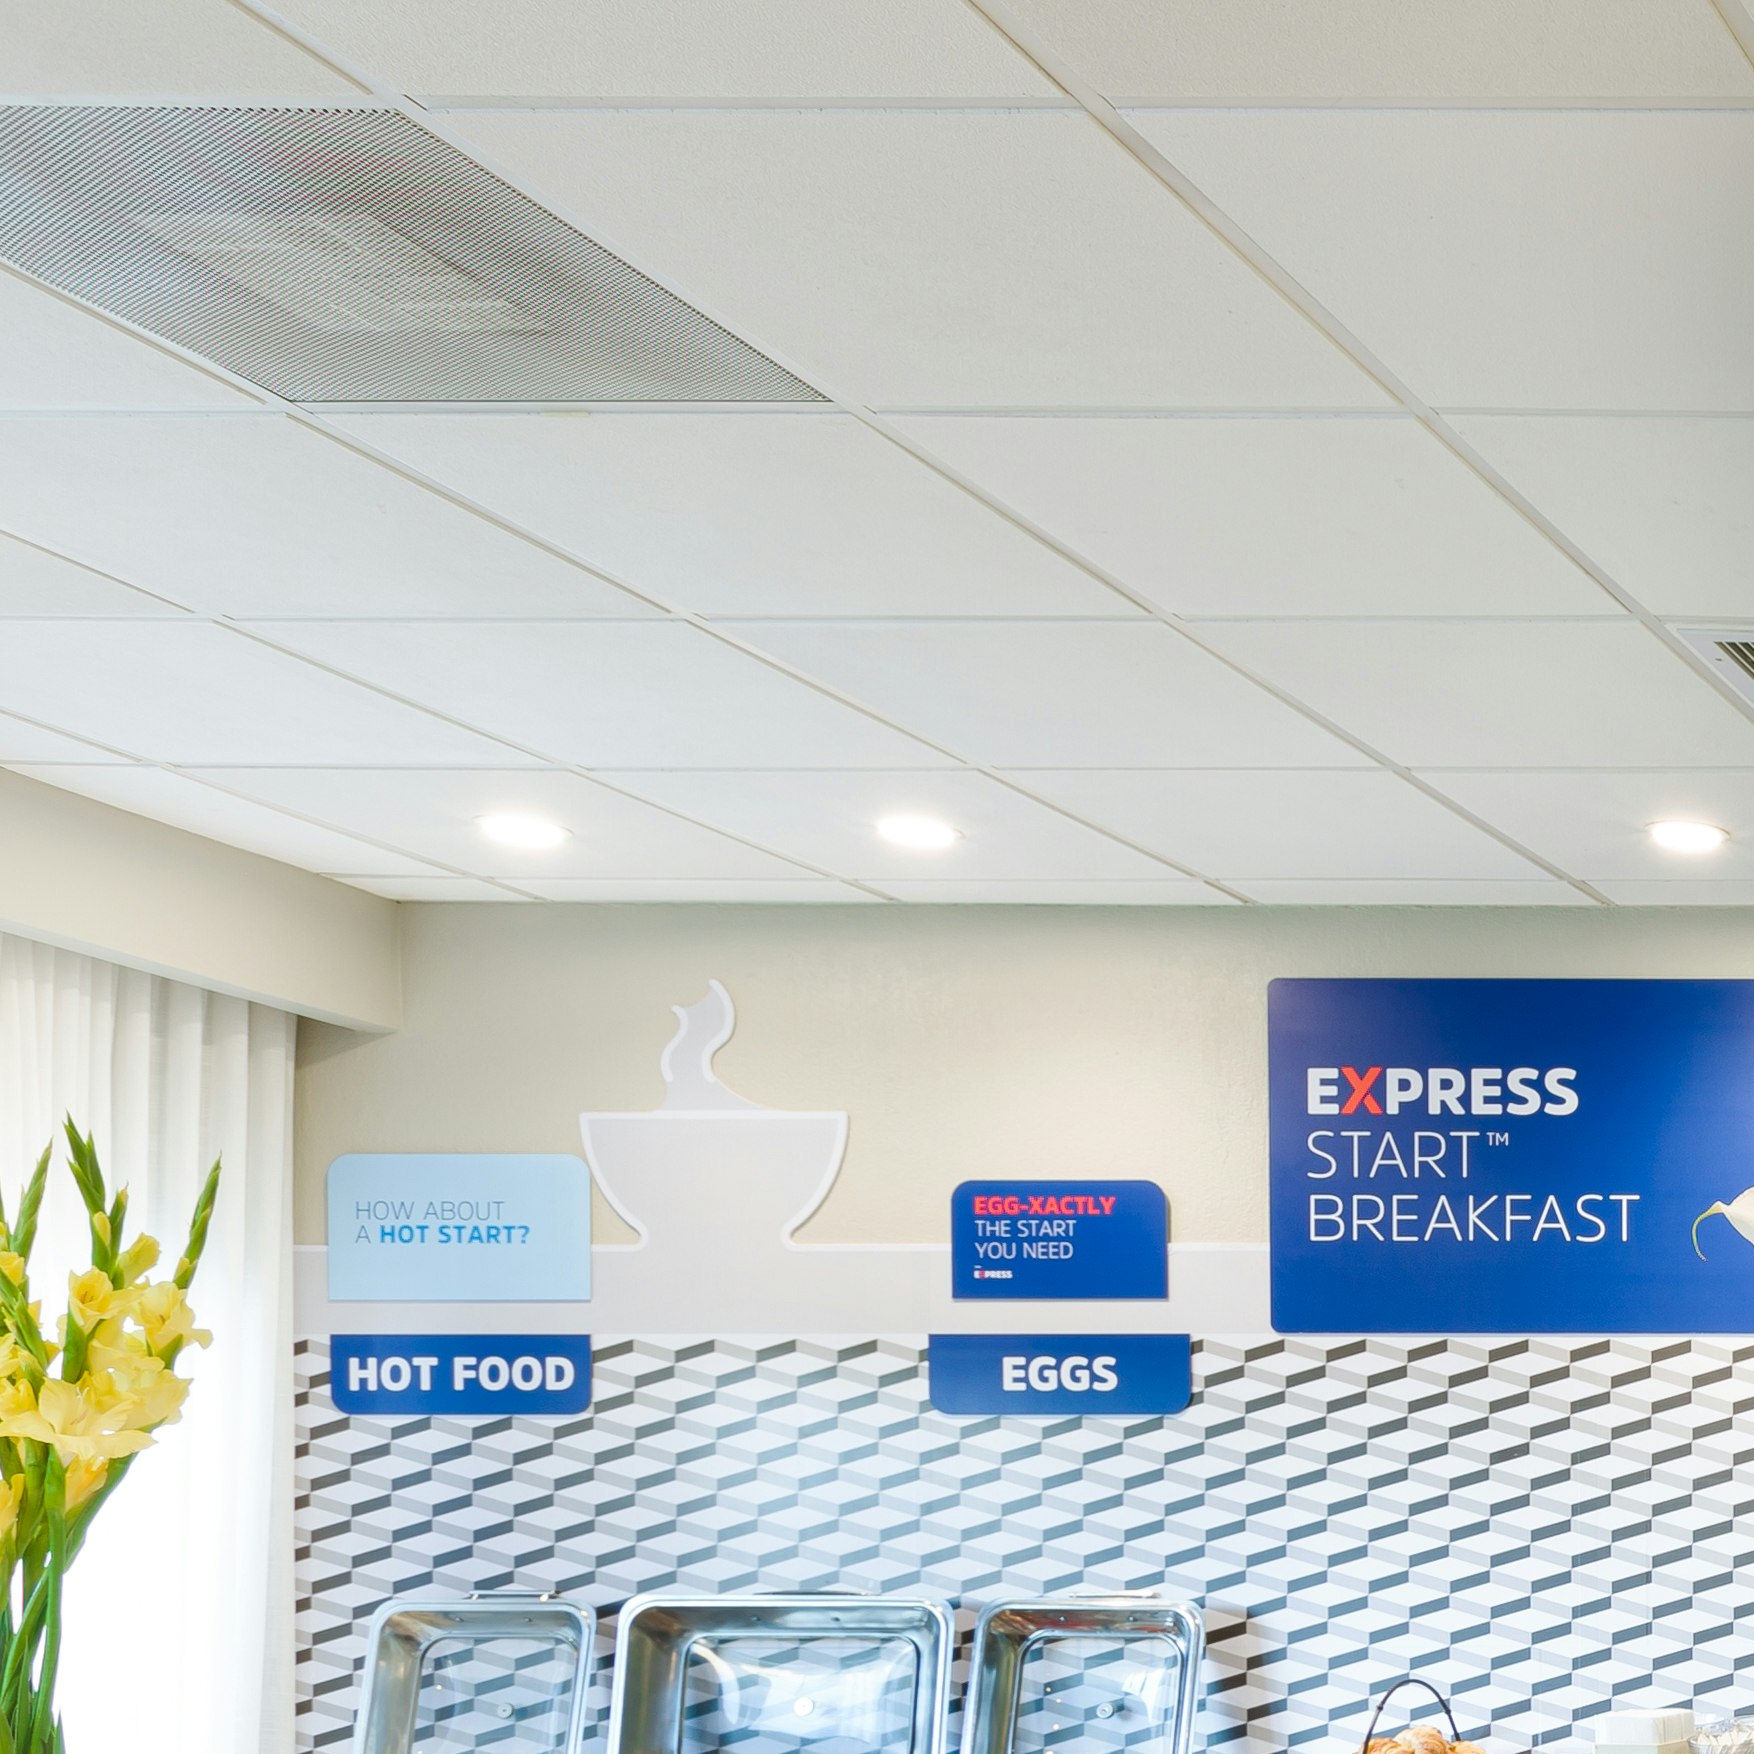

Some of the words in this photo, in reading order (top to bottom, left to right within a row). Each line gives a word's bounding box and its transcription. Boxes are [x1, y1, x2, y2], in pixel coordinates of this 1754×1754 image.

[1306, 1066, 1580, 1116] EXPRESS
[355, 1200, 415, 1221] HOW
[423, 1200, 505, 1221] ABOUT
[974, 1196, 1117, 1215] EGG-XACTLY
[1308, 1193, 1641, 1242] BREAKFAST
[355, 1225, 371, 1244] A
[380, 1225, 429, 1244] HOT
[438, 1225, 531, 1245] START?
[974, 1219, 1012, 1237] THE
[1017, 1219, 1077, 1238] START
[974, 1241, 1017, 1260] YOU
[1022, 1241, 1074, 1260] NEED
[348, 1356, 439, 1392] HOT
[453, 1356, 575, 1392] FOOD
[1002, 1356, 1119, 1392] EGGS
